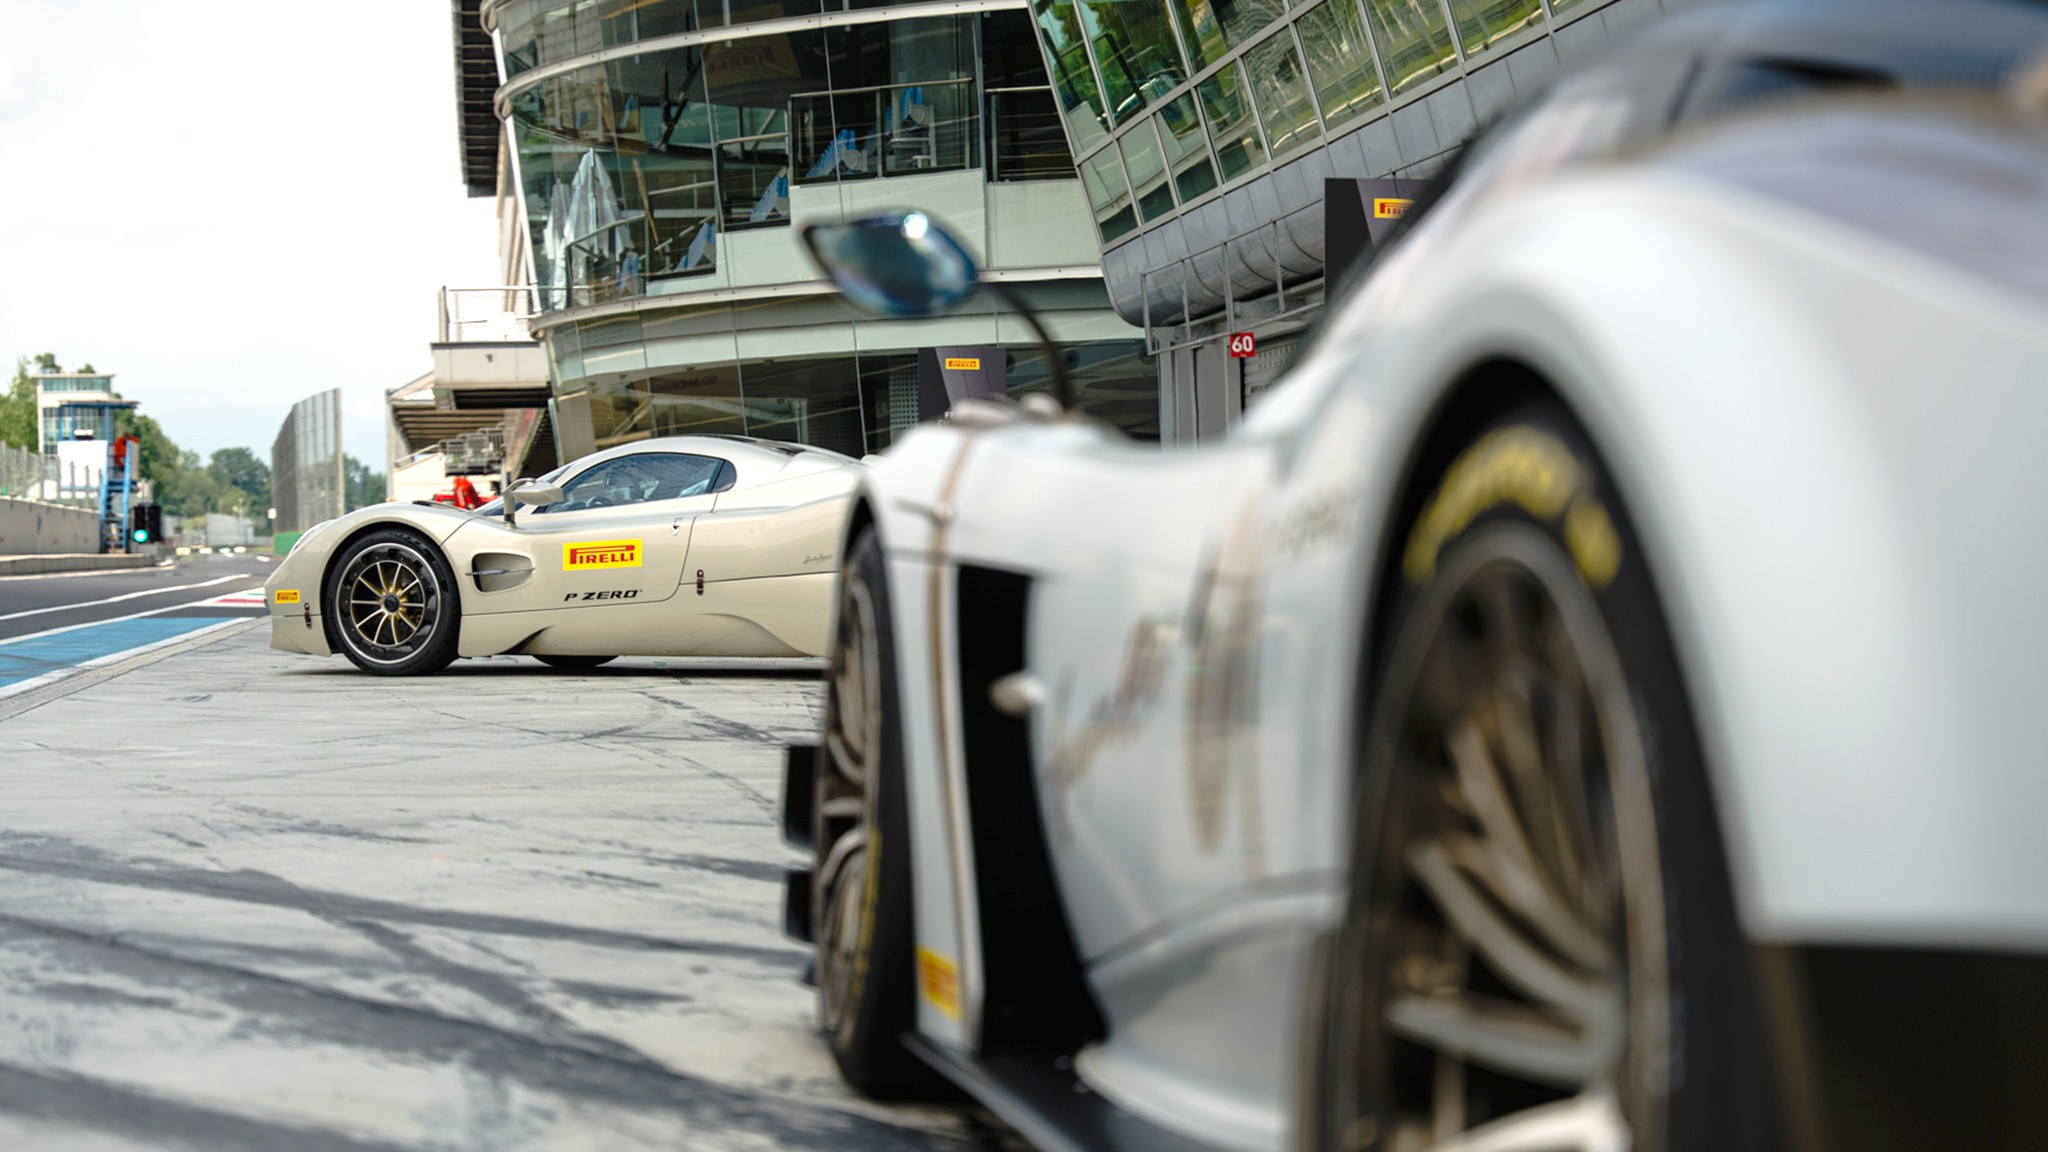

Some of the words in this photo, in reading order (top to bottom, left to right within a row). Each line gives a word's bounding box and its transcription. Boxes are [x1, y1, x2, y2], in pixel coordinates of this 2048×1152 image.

[1232, 335, 1253, 352] 60
[948, 360, 977, 368] PIRELLI
[570, 545, 635, 564] PIRELLI
[564, 593, 578, 601] P
[581, 590, 639, 600] ZERO
